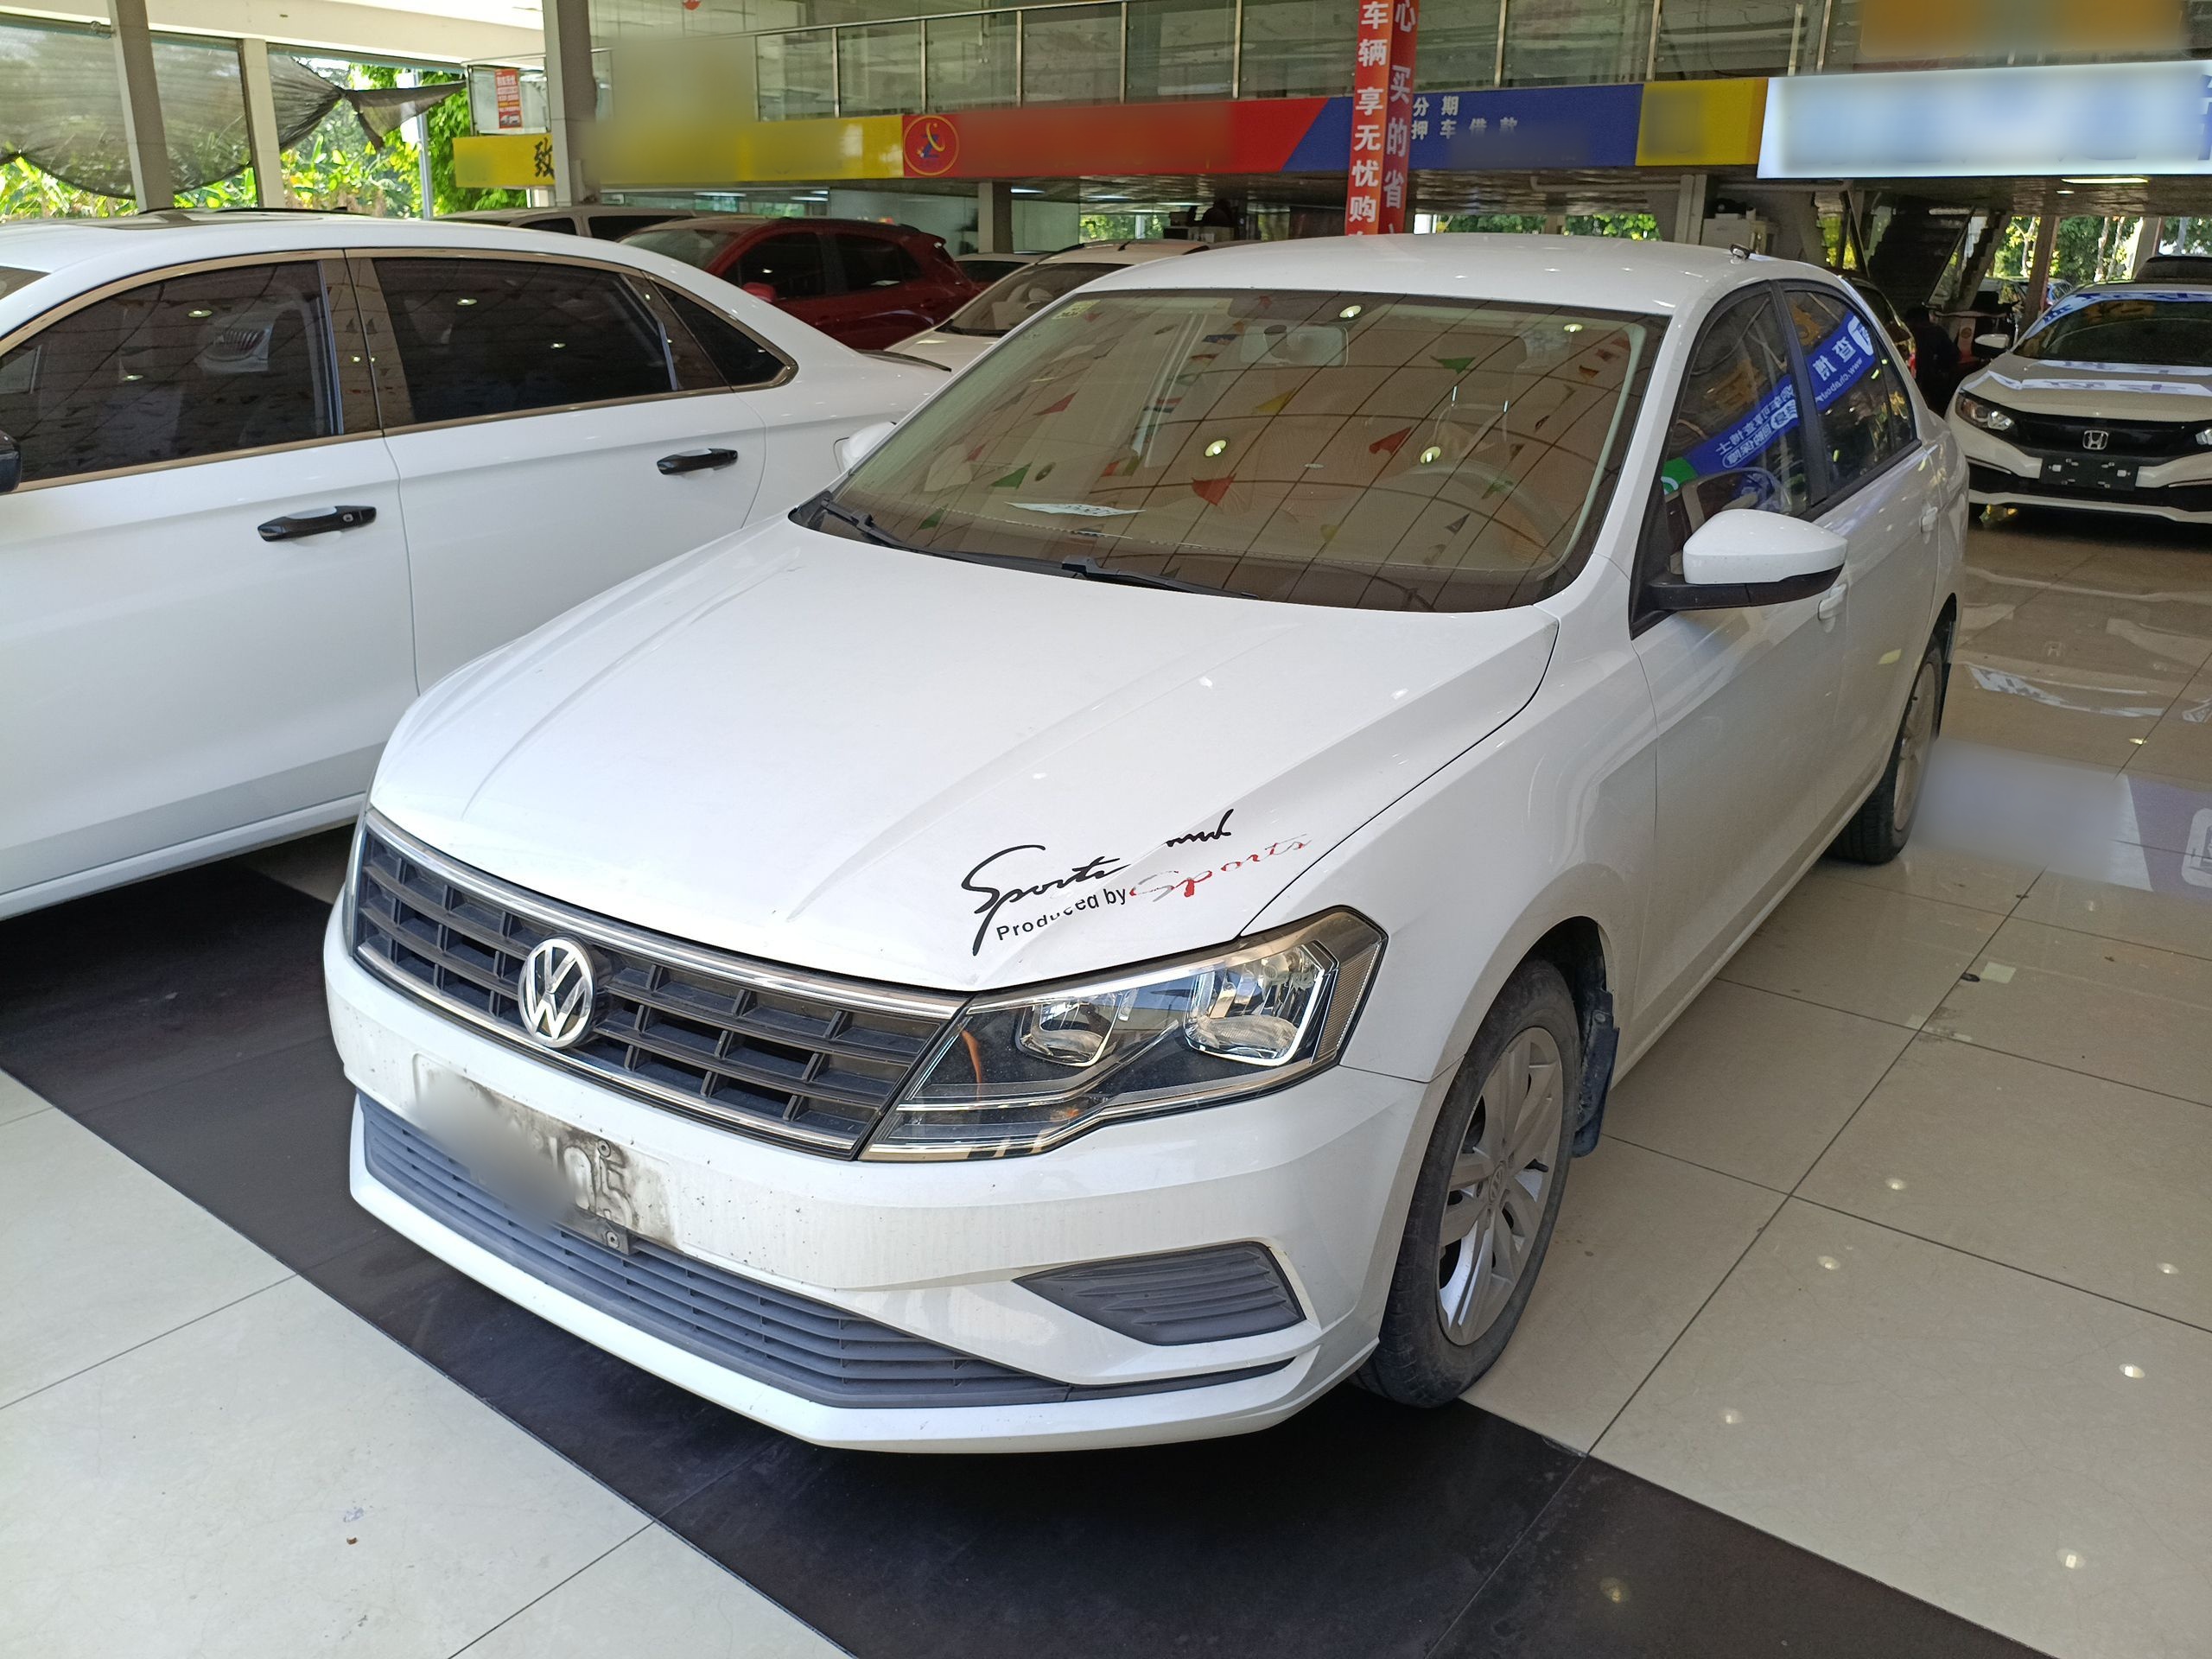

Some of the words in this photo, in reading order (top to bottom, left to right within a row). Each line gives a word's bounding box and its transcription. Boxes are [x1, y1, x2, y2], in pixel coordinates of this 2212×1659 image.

[1413, 95, 1460, 117] 分期
[1348, 1, 1389, 236] 车辆享无忧购
[1103, 887, 1127, 906] by
